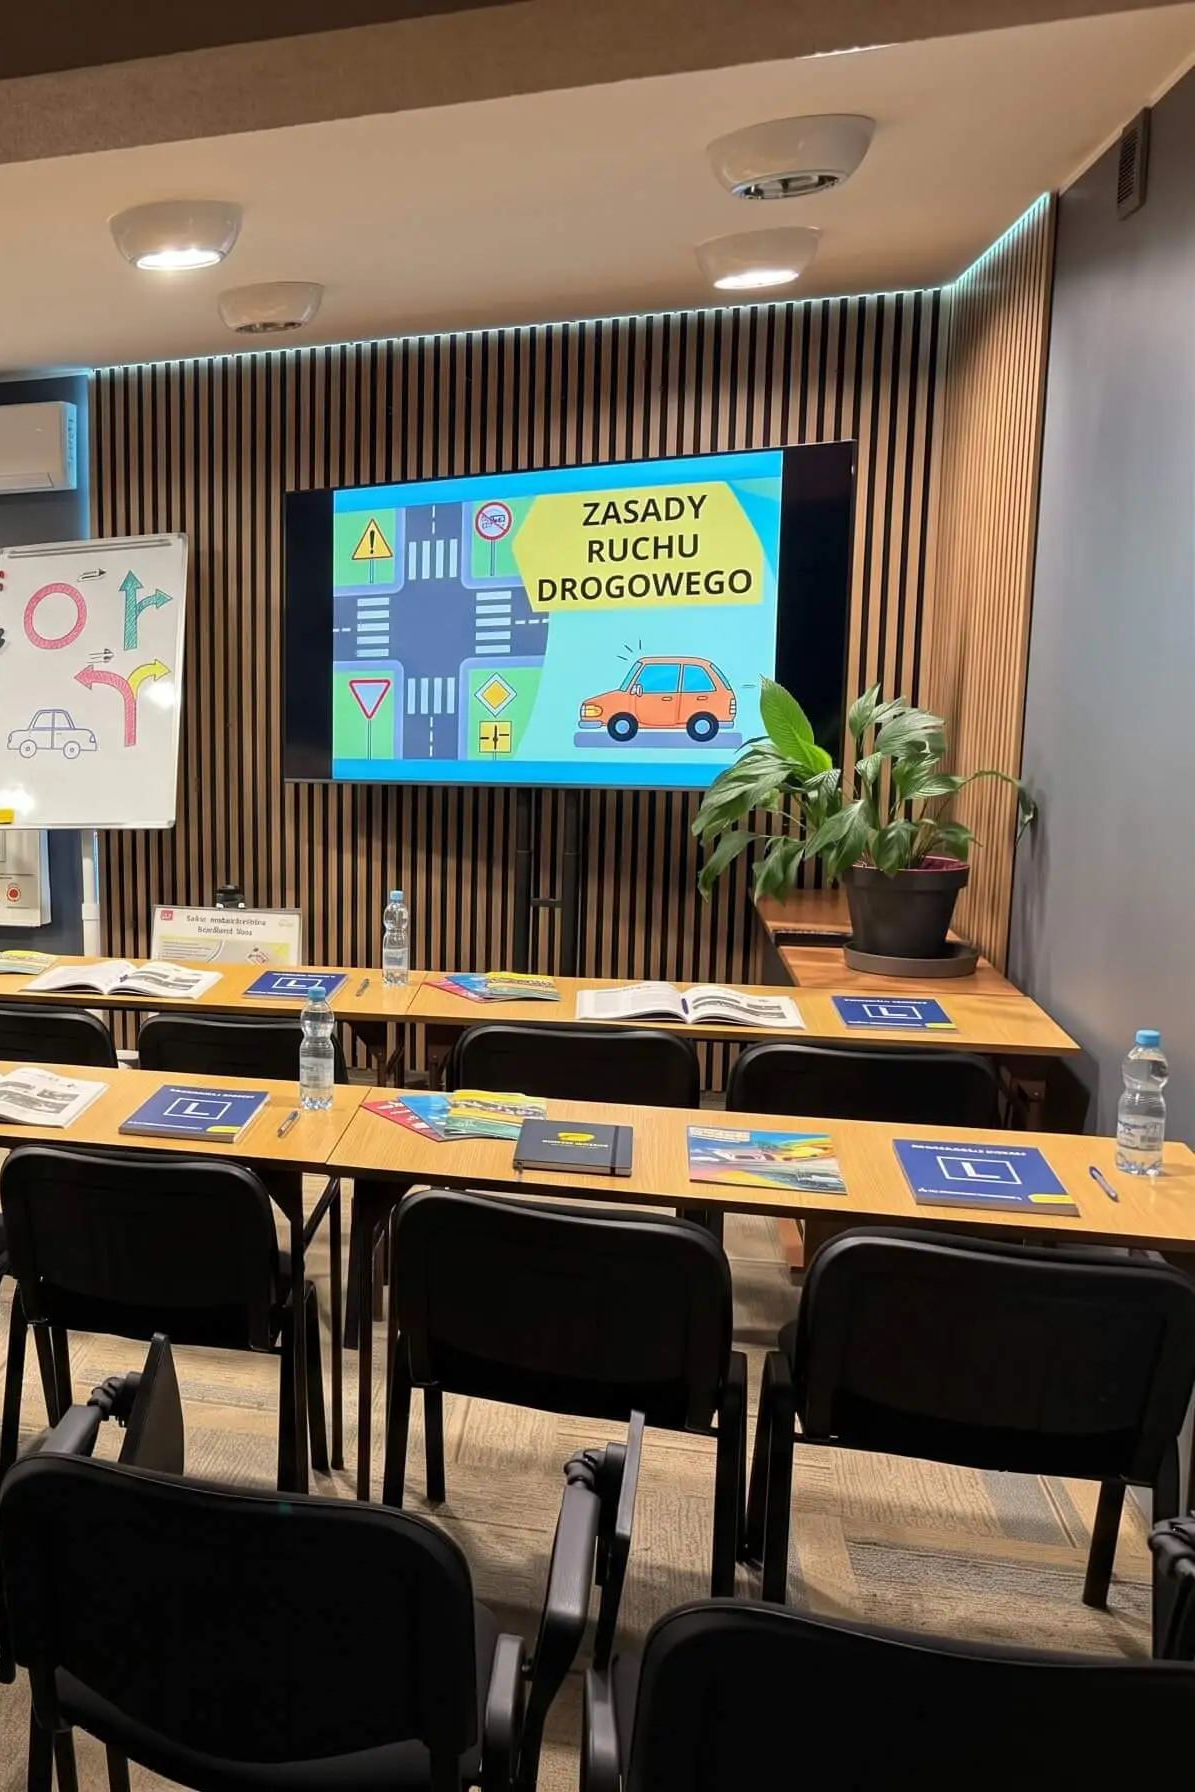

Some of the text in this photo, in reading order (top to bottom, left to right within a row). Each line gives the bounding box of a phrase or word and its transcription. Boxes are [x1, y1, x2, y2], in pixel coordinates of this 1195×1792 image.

[582, 494, 708, 526] ZASADY
[587, 533, 699, 563] RUCHU
[537, 568, 753, 602] DROGOWEGO
